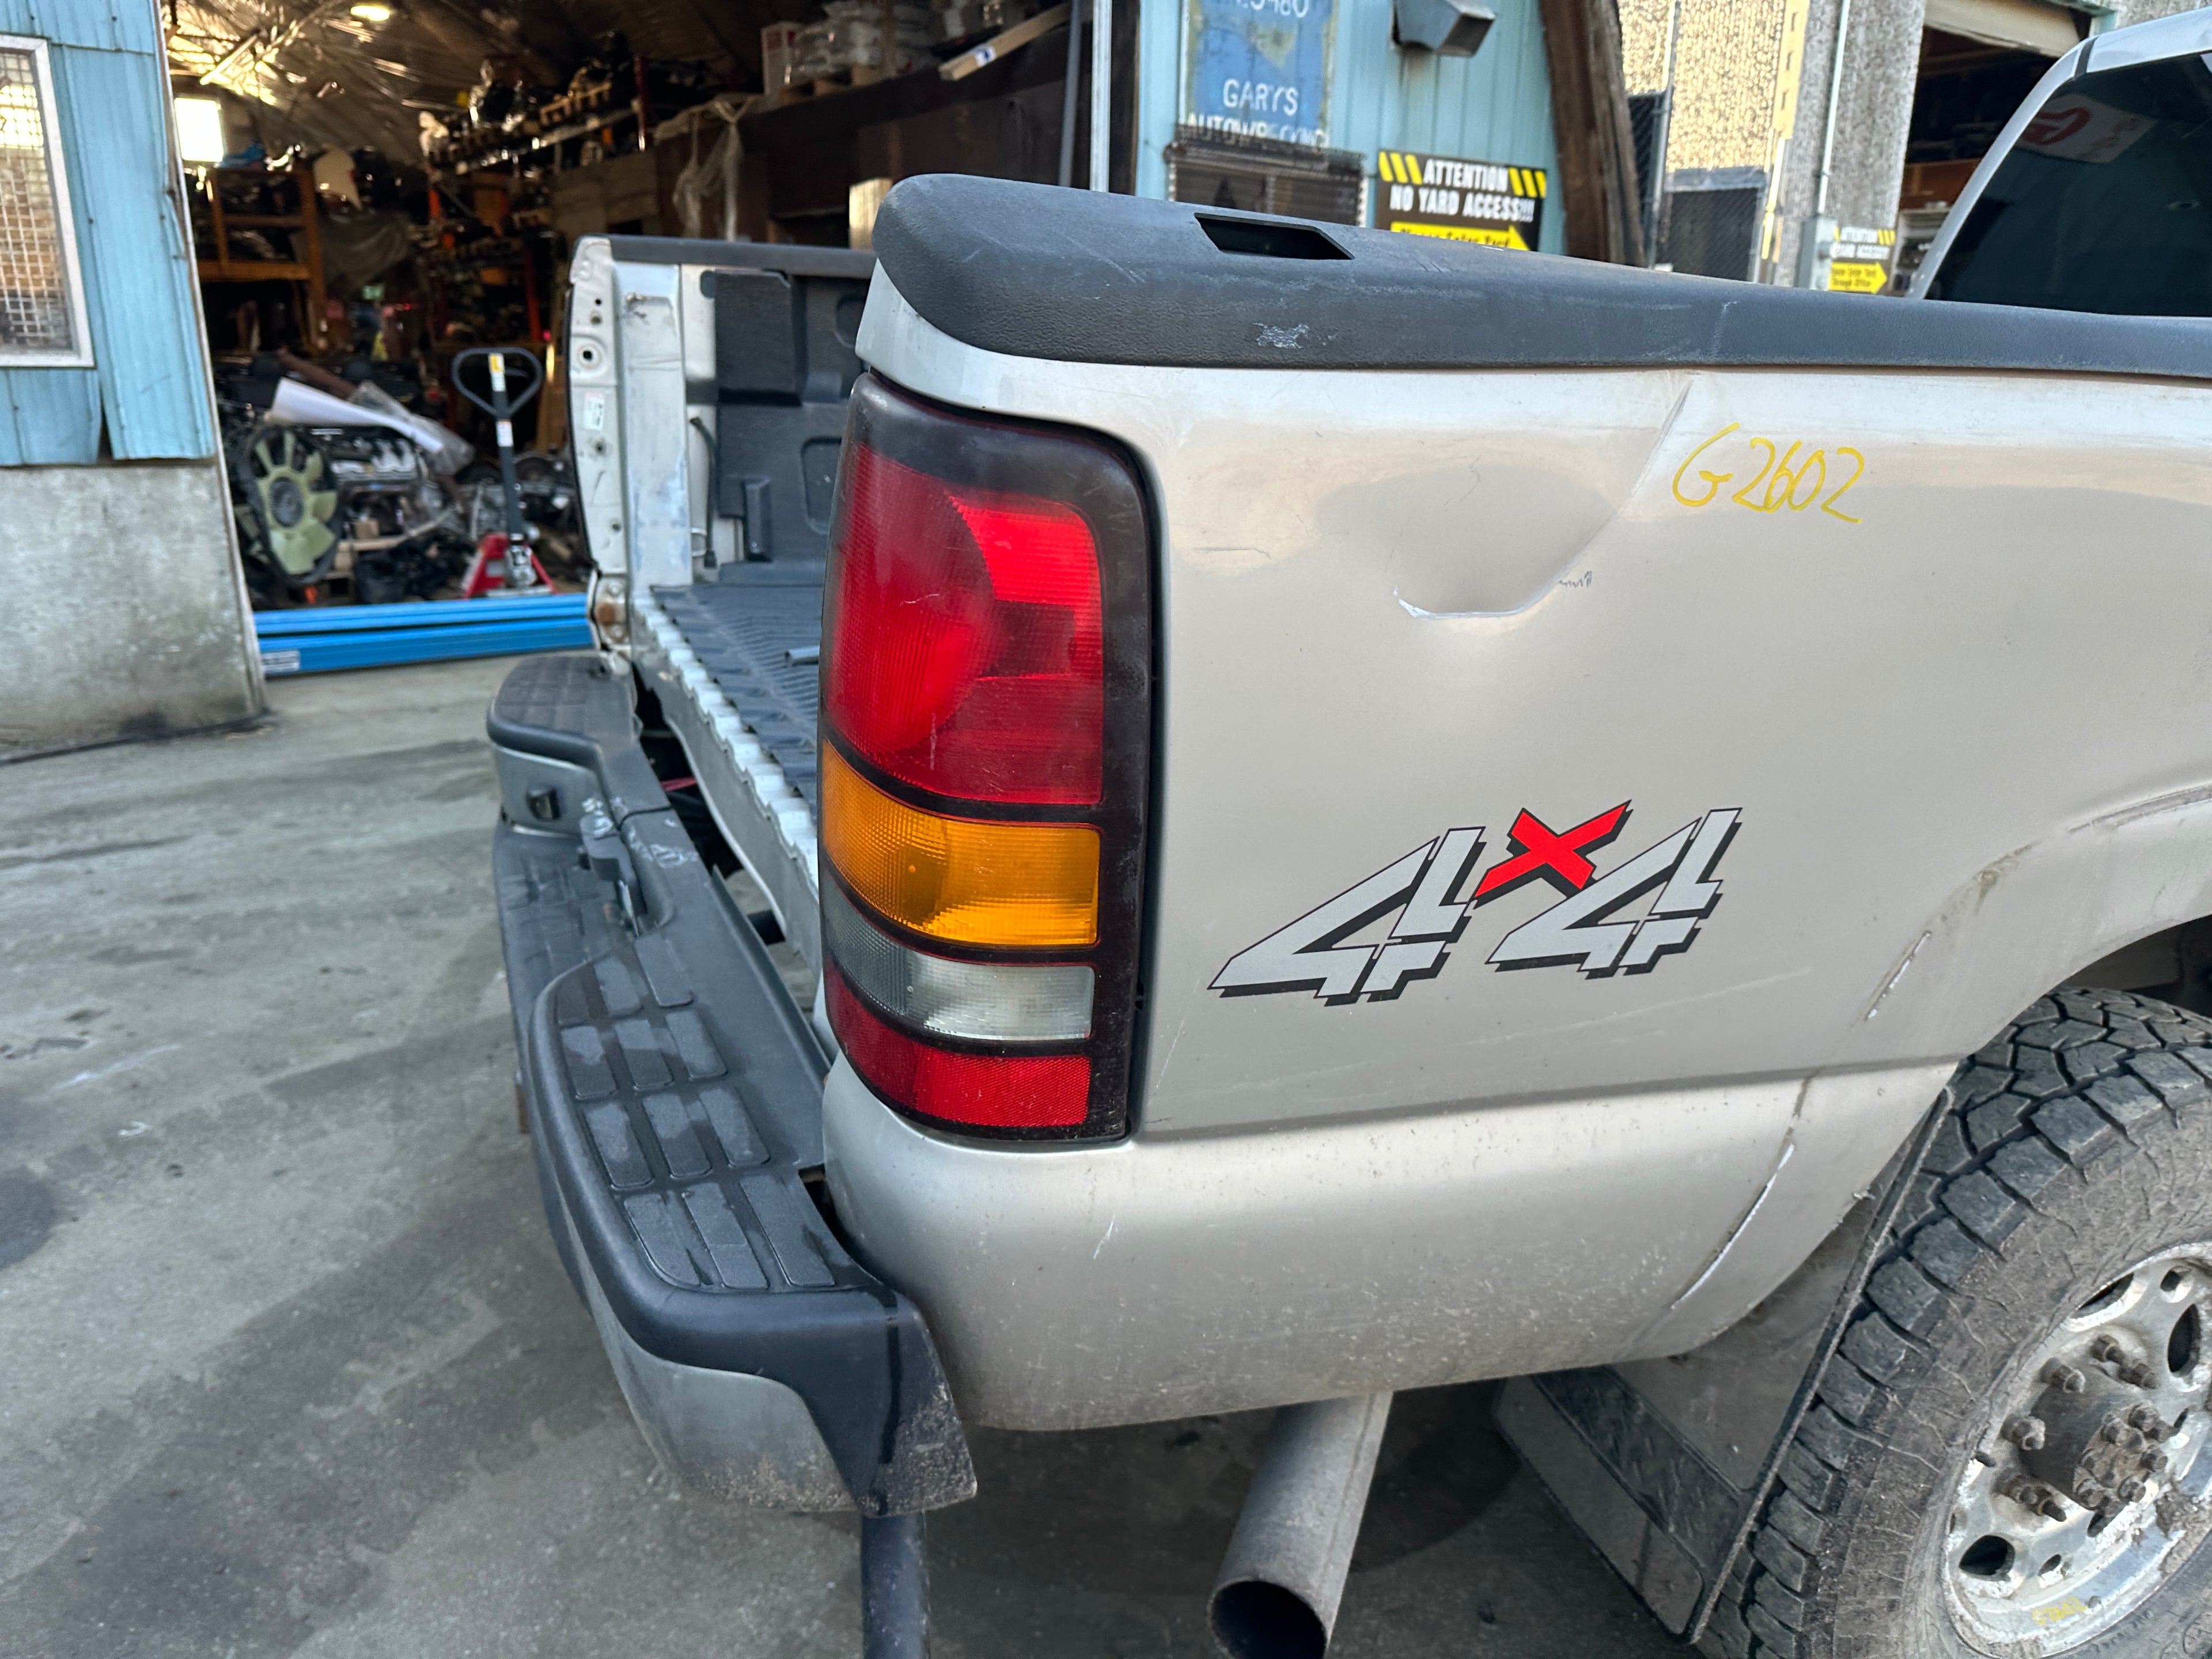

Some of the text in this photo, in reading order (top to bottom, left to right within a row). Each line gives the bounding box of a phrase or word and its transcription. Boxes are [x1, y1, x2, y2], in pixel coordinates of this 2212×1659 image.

[1222, 78, 1299, 116] GARYS
[1423, 158, 1508, 192] ATTENTION
[1389, 184, 1414, 211] NO
[1418, 187, 1460, 215] YARD
[1672, 422, 1865, 524] G2602
